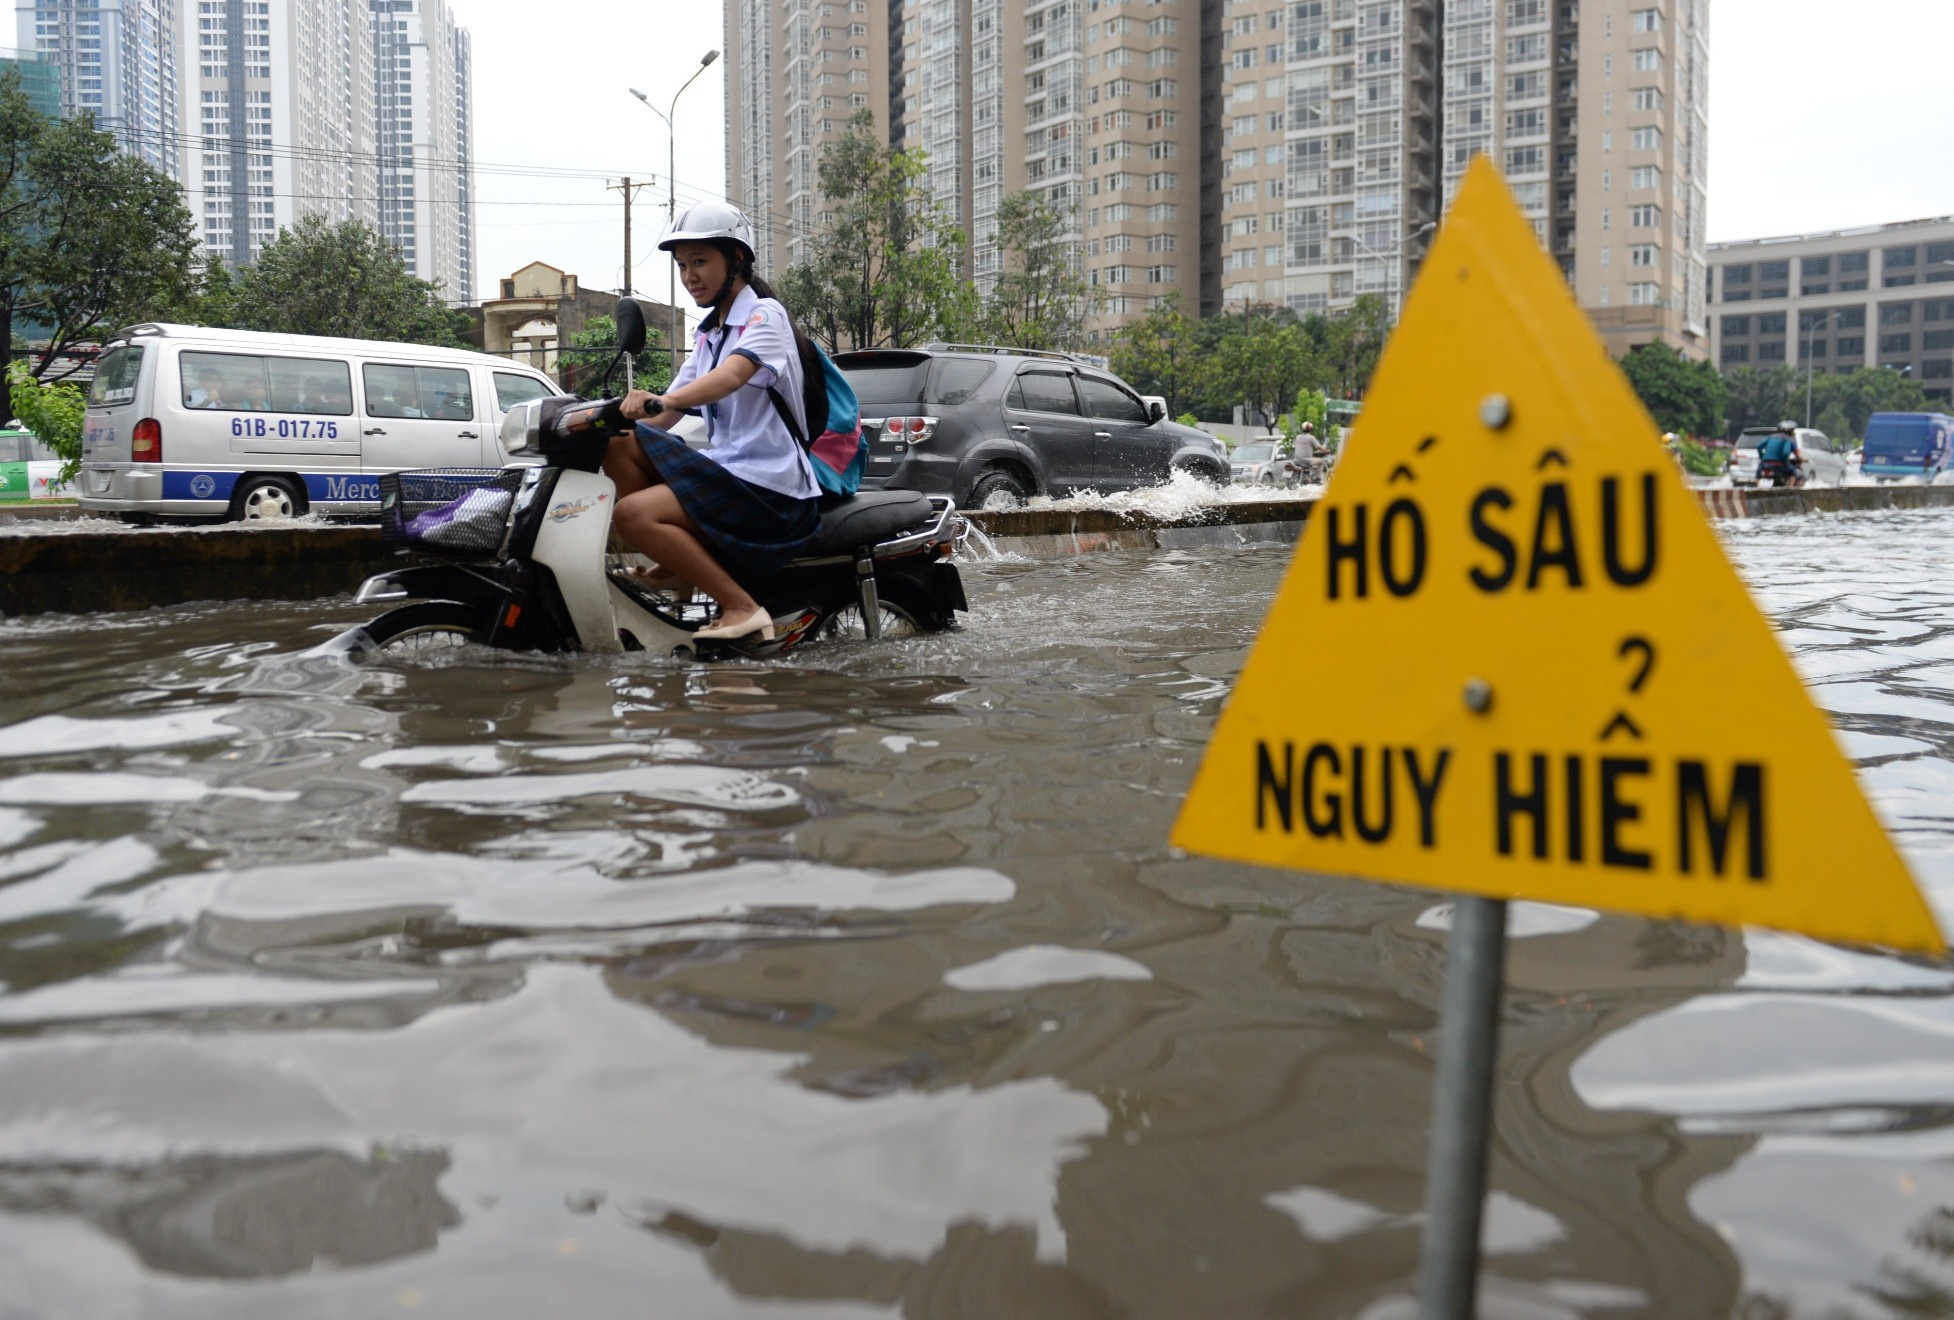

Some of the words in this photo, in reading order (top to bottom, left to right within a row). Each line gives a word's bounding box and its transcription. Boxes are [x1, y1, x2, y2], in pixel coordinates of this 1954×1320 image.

[231, 417, 338, 440] 61B-017.75
[1325, 436, 1436, 601] HỐ
[1467, 448, 1660, 595] SÂU
[1254, 739, 1452, 850] NGUY
[1492, 634, 1769, 883] HIỂM
